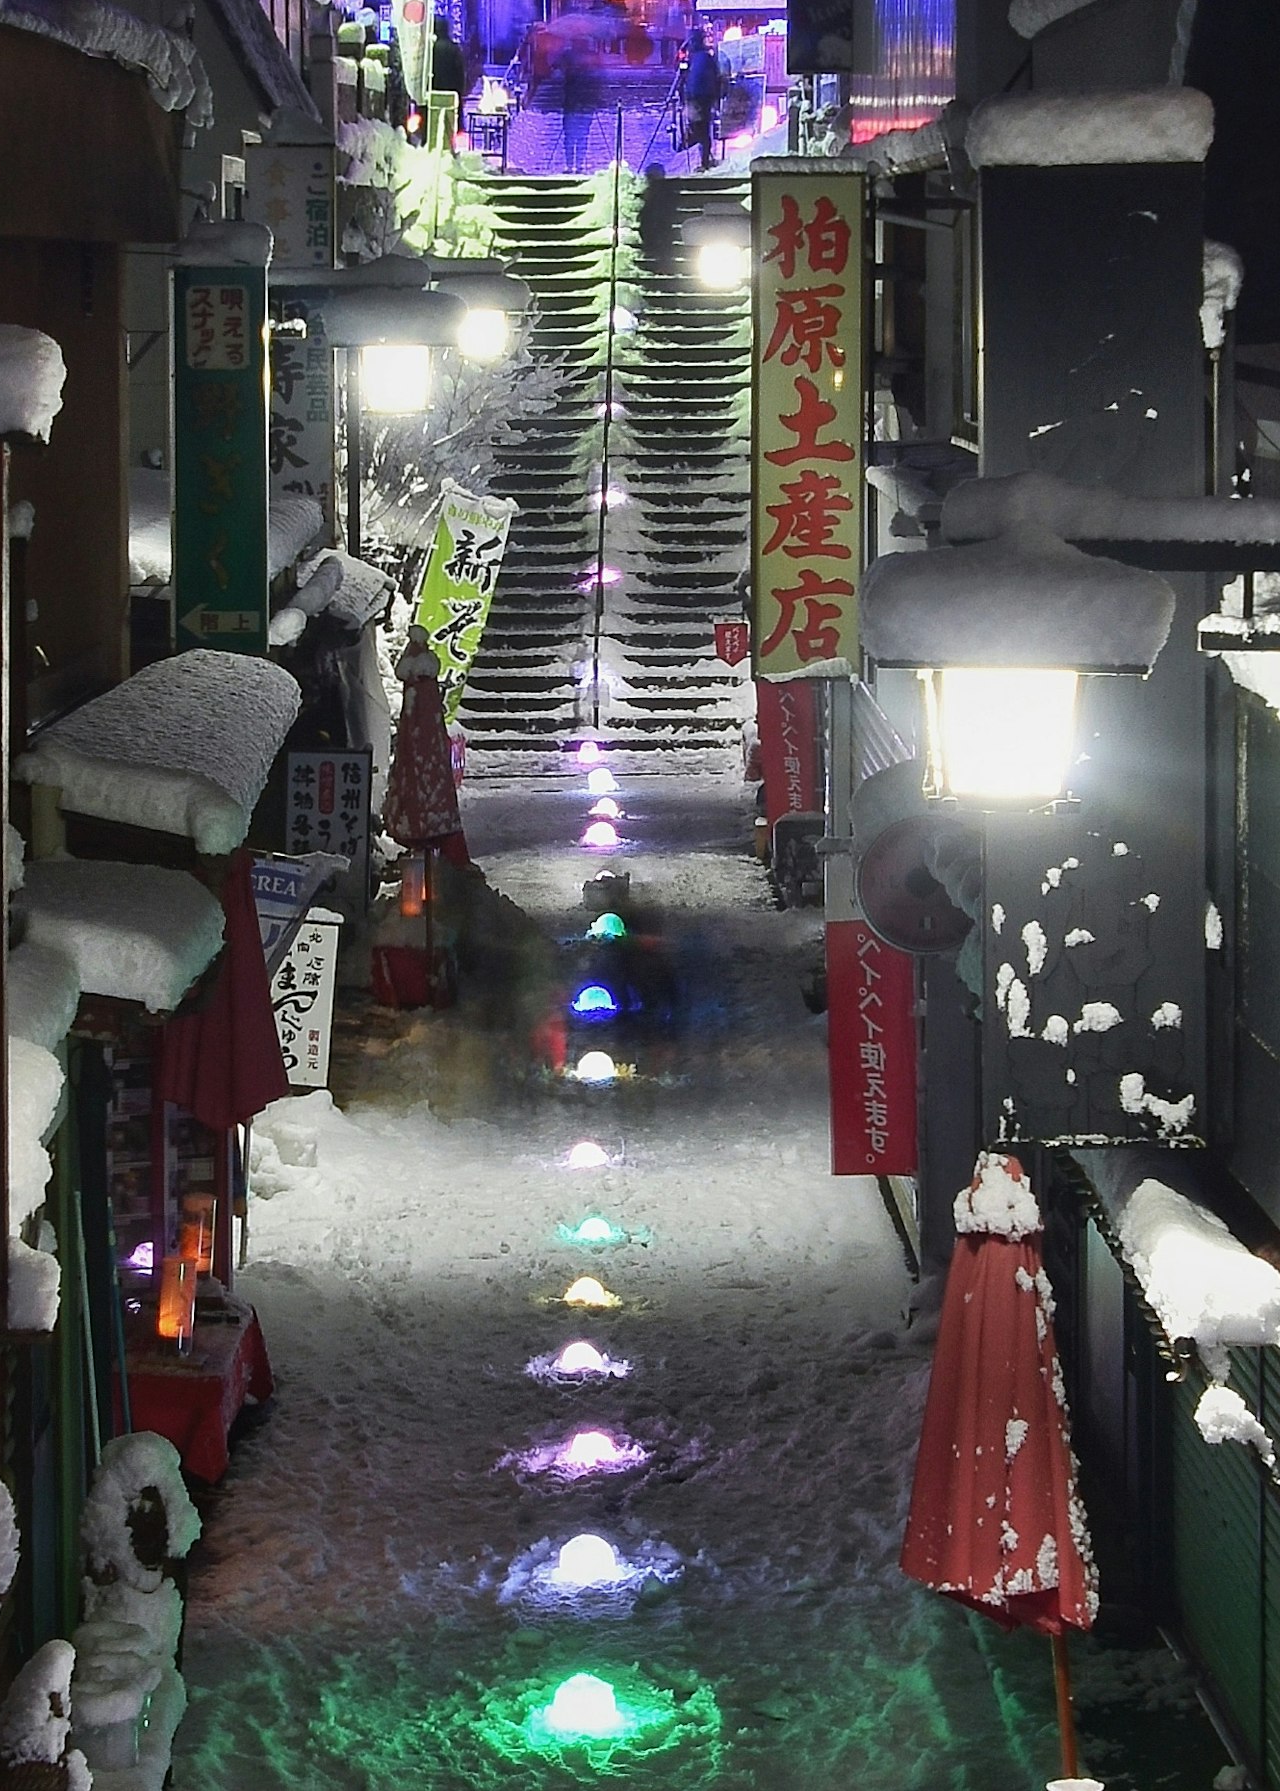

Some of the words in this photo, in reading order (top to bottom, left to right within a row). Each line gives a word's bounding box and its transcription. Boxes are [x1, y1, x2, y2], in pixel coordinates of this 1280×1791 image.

[761, 196, 857, 664] 柏原土産店
